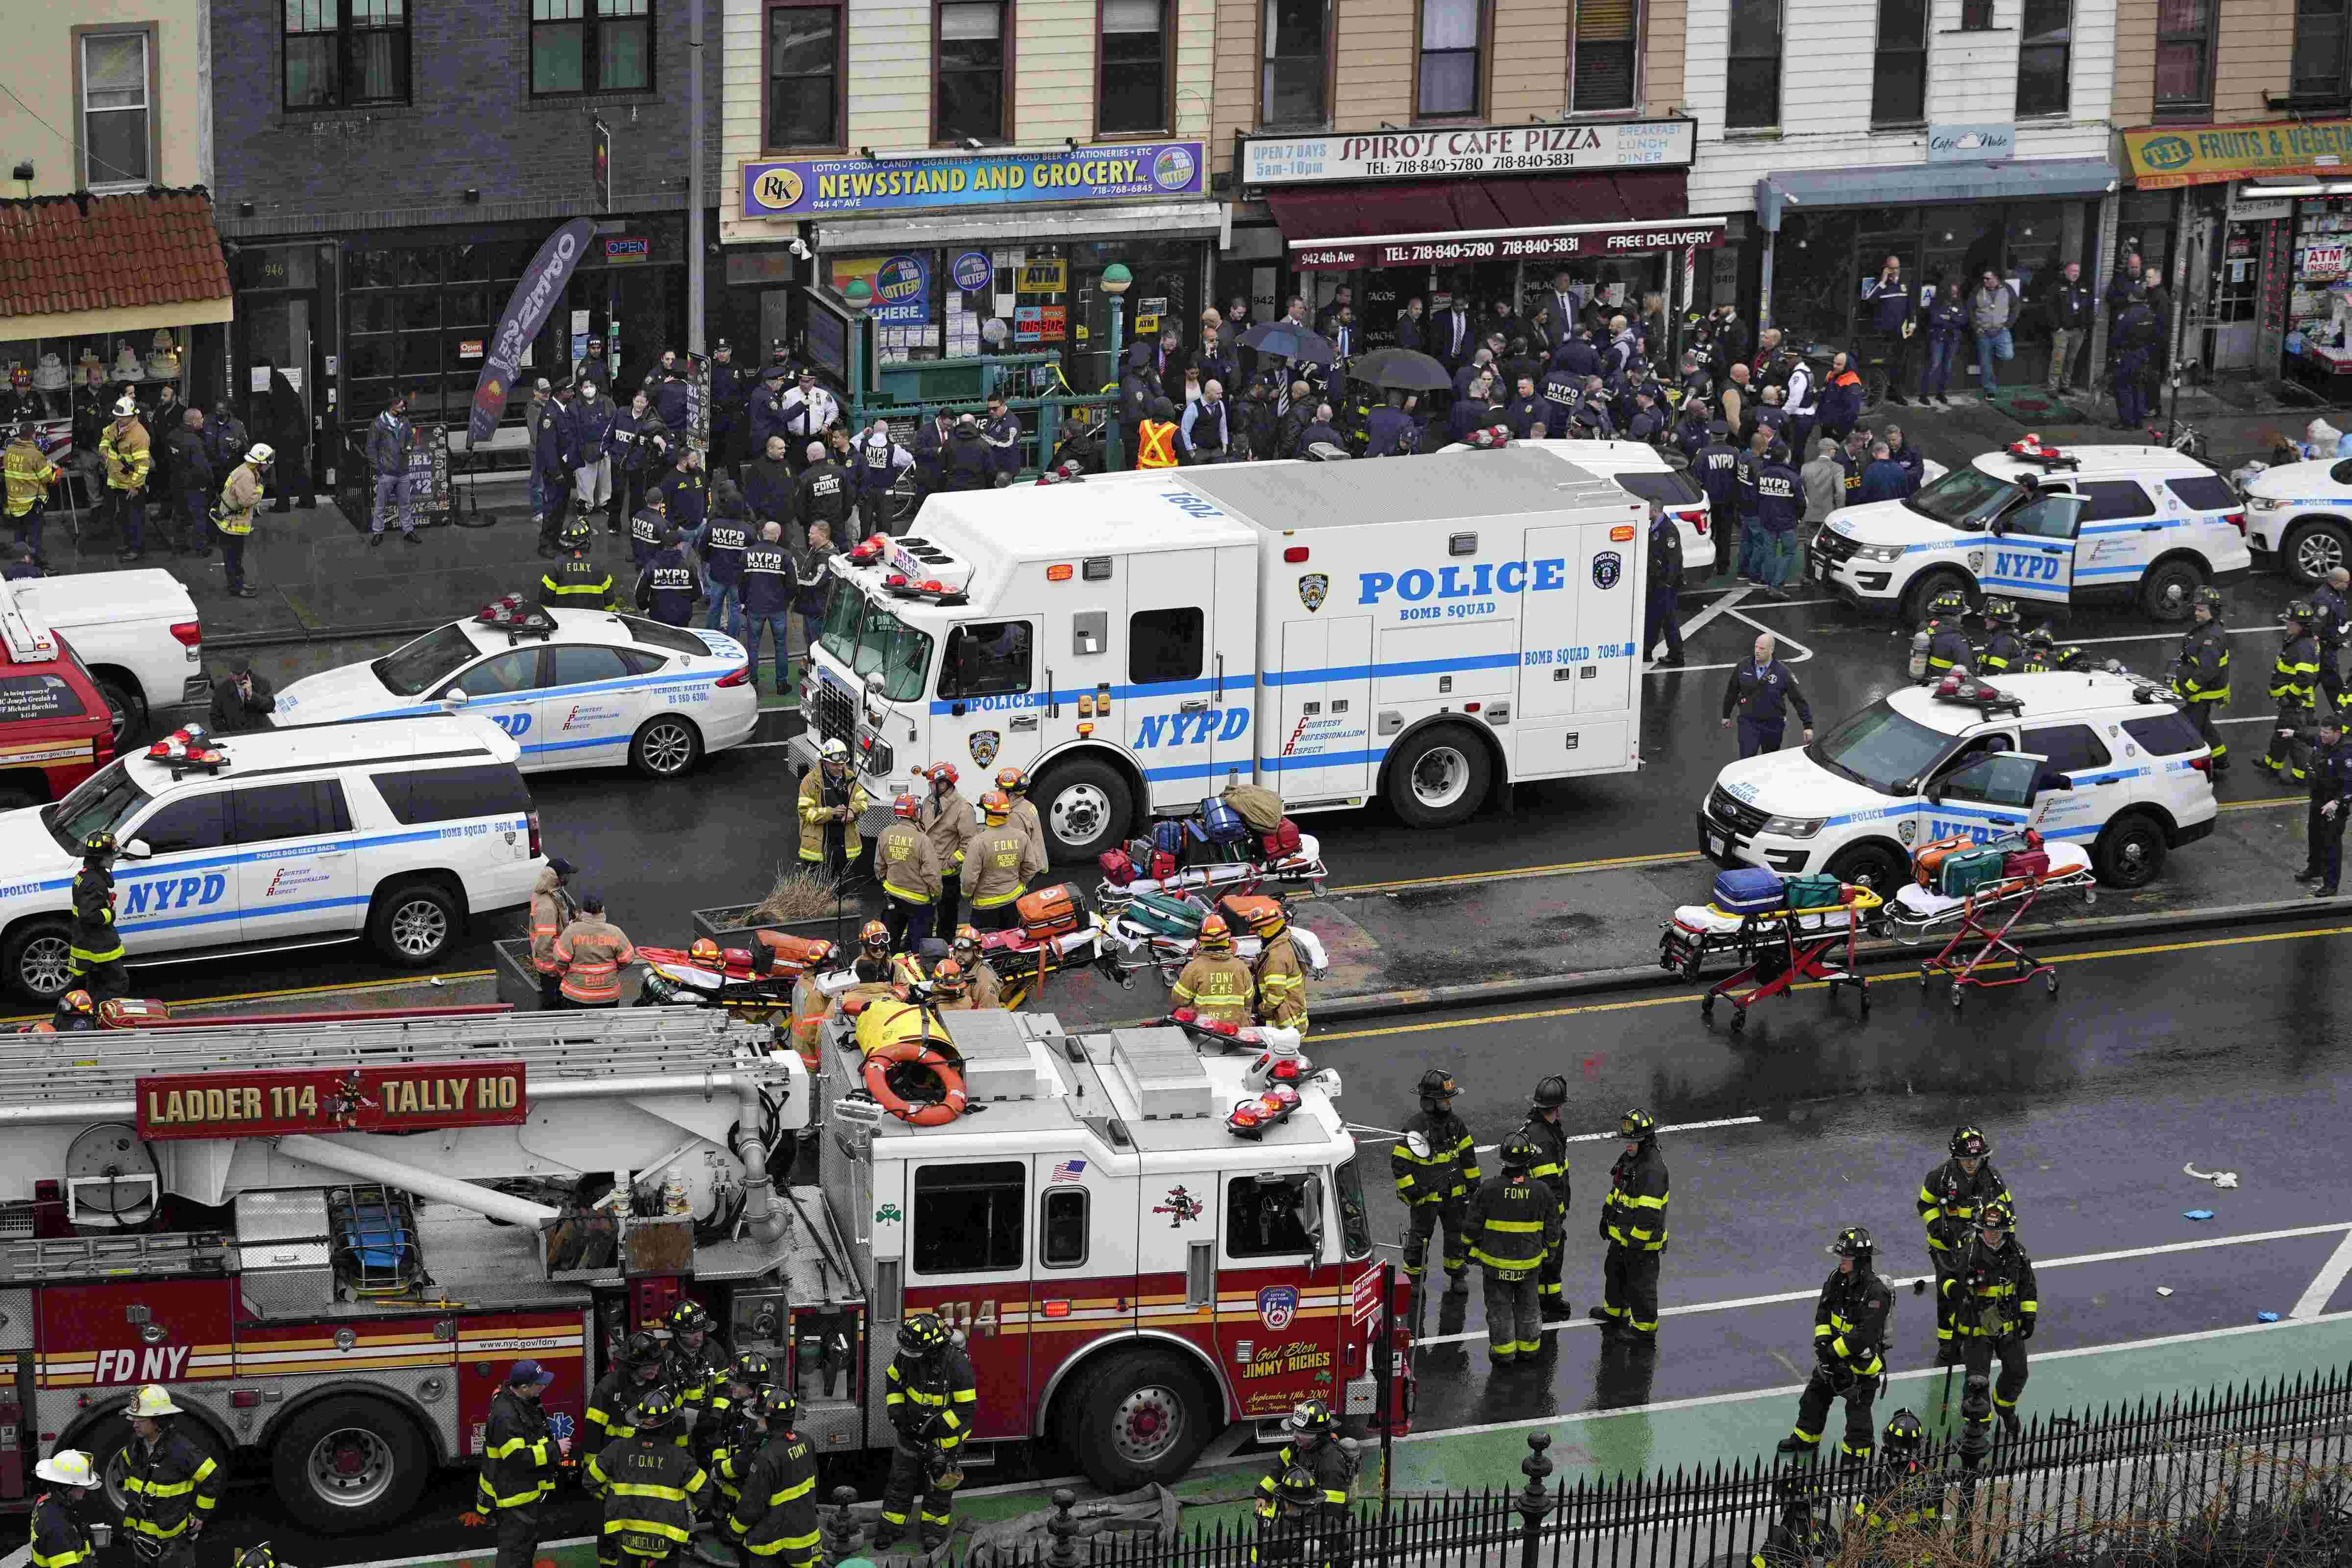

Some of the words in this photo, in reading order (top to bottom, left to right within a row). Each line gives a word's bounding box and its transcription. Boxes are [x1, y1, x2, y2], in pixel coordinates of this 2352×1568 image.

[1618, 124, 1681, 136] BREAKFAST
[1339, 134, 1439, 161] SPIRO'S
[1448, 131, 1514, 155] CAFE
[1525, 127, 1601, 153] PIZZA
[1618, 139, 1668, 149] LUNCH
[1930, 136, 1955, 153] Cafe
[1979, 133, 2008, 147] Nube
[2198, 131, 2264, 159] FRUITS
[2270, 130, 2282, 156] &
[1253, 145, 1283, 161] OPEN
[1285, 145, 1294, 156] 7
[1297, 144, 1326, 158] DAYS
[1618, 152, 1663, 163] DINER
[812, 163, 840, 172] LOTTO
[849, 162, 874, 170] SODA
[882, 159, 912, 169] CANDY
[922, 156, 973, 167] CIGARETTES
[982, 155, 1008, 163] CIGAR
[1016, 153, 1040, 162] COLD
[1042, 152, 1062, 161] BEER
[1070, 149, 1128, 160] STATIONERIES
[1136, 148, 1152, 156] ETC
[1366, 161, 1390, 175] TEL:
[1395, 157, 1483, 174] 718-840-5780
[1493, 153, 1574, 169] 718-840-5831
[1256, 162, 1323, 176] 5am-10pm
[819, 169, 967, 198] NEWSSTAND
[973, 163, 1025, 190] AND
[1032, 159, 1139, 188] GROCERY
[1092, 184, 1153, 195] 718-768-6845
[812, 200, 830, 210] 944
[844, 198, 861, 207] AVE
[1607, 235, 1644, 248] FREE
[1646, 231, 1714, 247] DELIVERY
[608, 240, 646, 254] OPEN
[1385, 247, 1408, 262] TEL:
[1412, 242, 1494, 260] 718-840-5780
[1502, 238, 1579, 255] 718-840-5831
[1301, 254, 1320, 265] 942
[1320, 252, 1336, 264] 4th
[1337, 251, 1355, 262] Ave
[2308, 249, 2342, 263] ATM
[265, 264, 284, 277] 946
[2307, 261, 2340, 270] INSIDE
[1027, 267, 1059, 283] ATM
[881, 279, 922, 299] LOTTERY
[1368, 291, 1396, 301] TACOS
[1252, 295, 1274, 306] 942
[1138, 319, 1154, 328] ATM
[461, 343, 482, 353] Open
[1548, 381, 1579, 398] NYPD
[7, 454, 24, 463] FDNY
[866, 446, 888, 458] NYPD
[1709, 454, 1734, 469] NYPD
[813, 478, 840, 492] FDNY
[1759, 477, 1789, 489] NYPD
[1759, 486, 1790, 495] POLICE
[1160, 491, 1224, 518] 7091
[2304, 498, 2331, 507] POLICE
[711, 528, 745, 541] NYPD
[711, 538, 745, 546] POLICE
[1927, 541, 1955, 551] POLICE
[747, 552, 782, 564] NYPD
[897, 548, 918, 569] NYPD
[1594, 553, 1620, 565] POLICE
[747, 561, 781, 570] POLICE
[1994, 553, 2058, 580] NYPD
[654, 568, 689, 580] NYPD
[1357, 558, 1565, 604] POLICE
[1399, 606, 1442, 621] BOMB
[1447, 602, 1496, 618] SQUAD
[1524, 650, 1553, 666] BOMB
[1556, 647, 1590, 663] SQUAD
[1597, 645, 1620, 659] 7091
[653, 686, 682, 695] SCHOOL
[683, 683, 710, 692] SAFETY
[6, 697, 26, 706] Joseph
[692, 693, 706, 701] 6301
[970, 694, 1034, 713] POLICE
[7, 704, 31, 713] Michael
[1132, 707, 1251, 750] NYPD
[1298, 716, 1344, 730] COURTESY
[1291, 729, 1367, 743] PROFESSIONALISM
[19, 750, 76, 761] www.nyc.gov/fdny
[1282, 742, 1323, 756] RESPECT
[1727, 784, 1755, 803] POLICE
[1851, 810, 1884, 822] POLICE
[441, 827, 462, 839] BOMB
[464, 824, 487, 837] SQUAD
[494, 821, 511, 832] 5674
[256, 849, 281, 859] POLICE
[889, 845, 910, 855] RESCUE
[891, 853, 906, 861] MEDIC
[997, 853, 1018, 862] RESCUE
[276, 868, 311, 877] COURTESY
[2, 881, 39, 898] POLICE
[124, 873, 226, 916] NYPD
[1209, 972, 1234, 984] FDNY
[149, 1086, 263, 1124] LADDER
[270, 1084, 319, 1118] 114
[382, 1078, 470, 1113] TALLY
[477, 1076, 517, 1110] HO
[1504, 1187, 1530, 1200] FDNY
[1354, 1282, 1361, 1292] NO
[1361, 1269, 1381, 1288] STOPPING
[1354, 1286, 1372, 1303] Anytime
[936, 1300, 997, 1337] 114
[479, 1337, 558, 1350] www.nyc.gov/fdny
[1256, 1345, 1281, 1362] God
[1284, 1341, 1318, 1357] Bless
[141, 1346, 188, 1380] NY
[1243, 1358, 1283, 1379] JIMMY
[1288, 1351, 1330, 1372] RICHES
[1247, 1391, 1286, 1404] September
[1309, 1389, 1330, 1400] 2001
[1295, 1411, 1306, 1422] 228
[787, 1442, 808, 1461] FDNY
